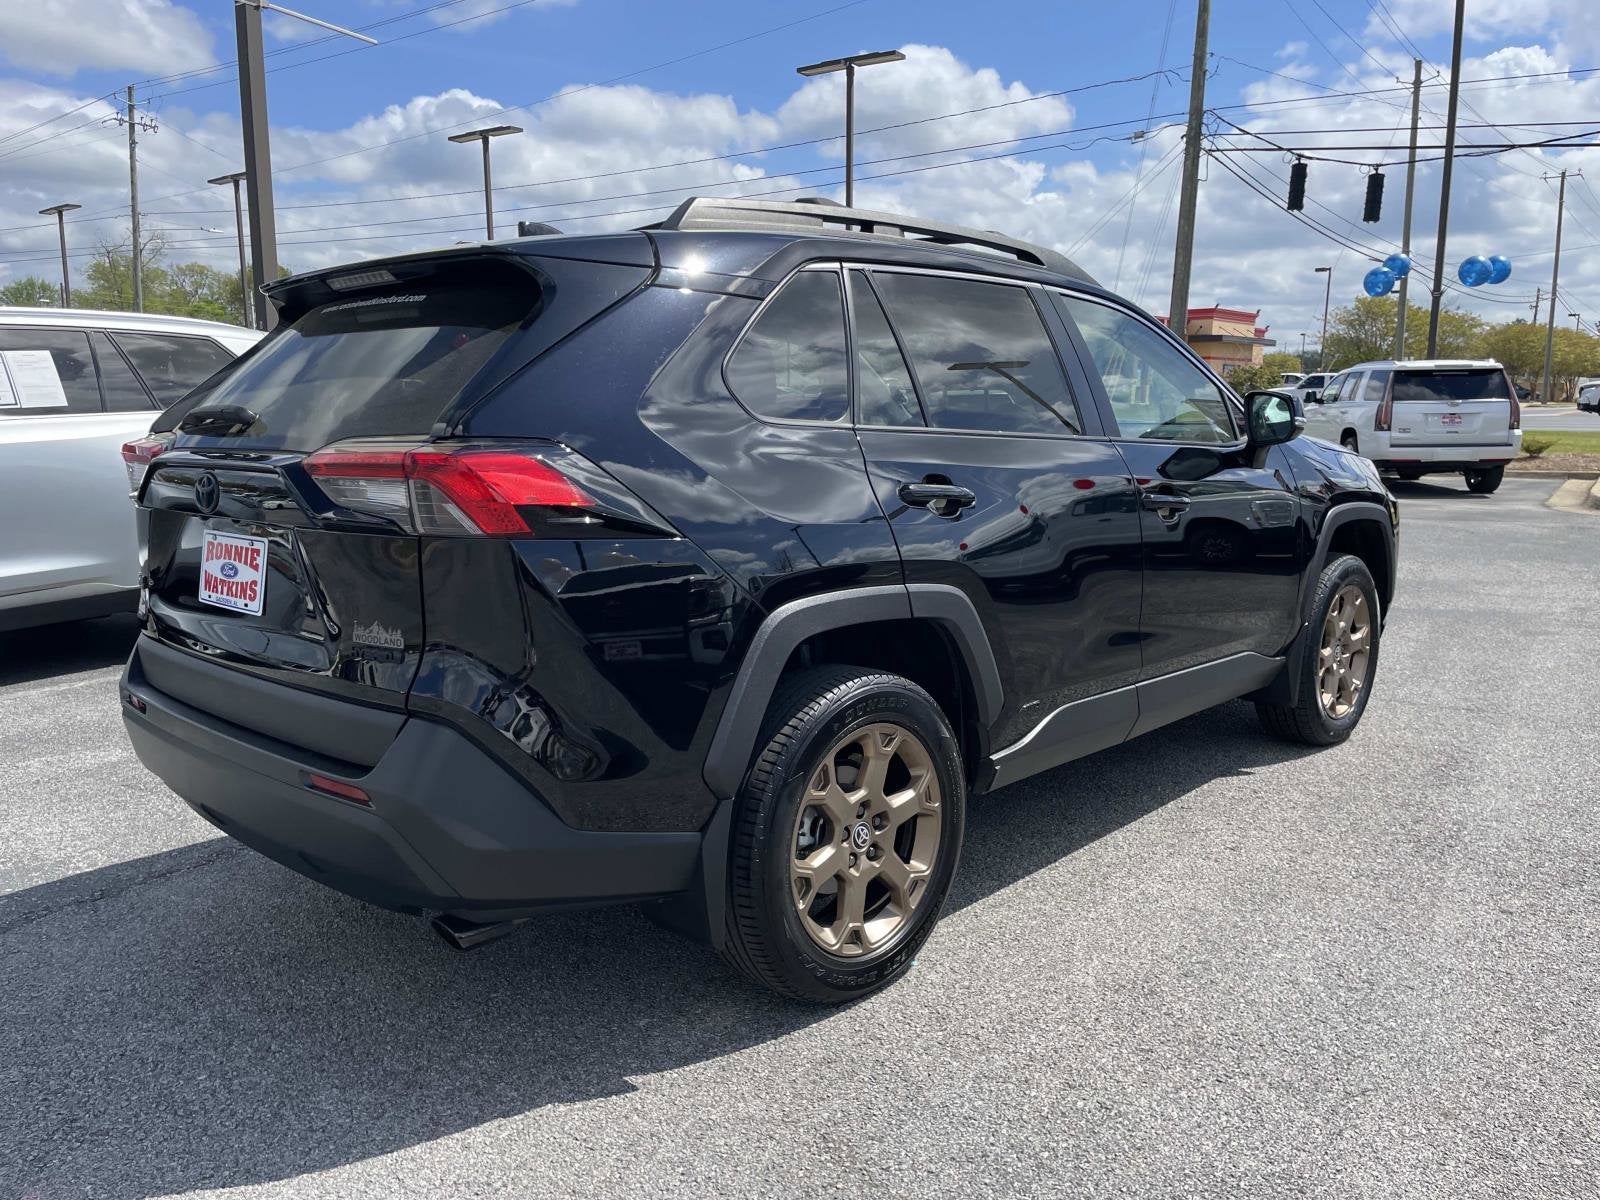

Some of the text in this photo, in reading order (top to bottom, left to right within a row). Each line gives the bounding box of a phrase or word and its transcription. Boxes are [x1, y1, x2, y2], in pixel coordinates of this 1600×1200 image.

[205, 540, 260, 573] RONNIE
[204, 569, 258, 602] WATKINS
[352, 631, 404, 648] WOODLAND
